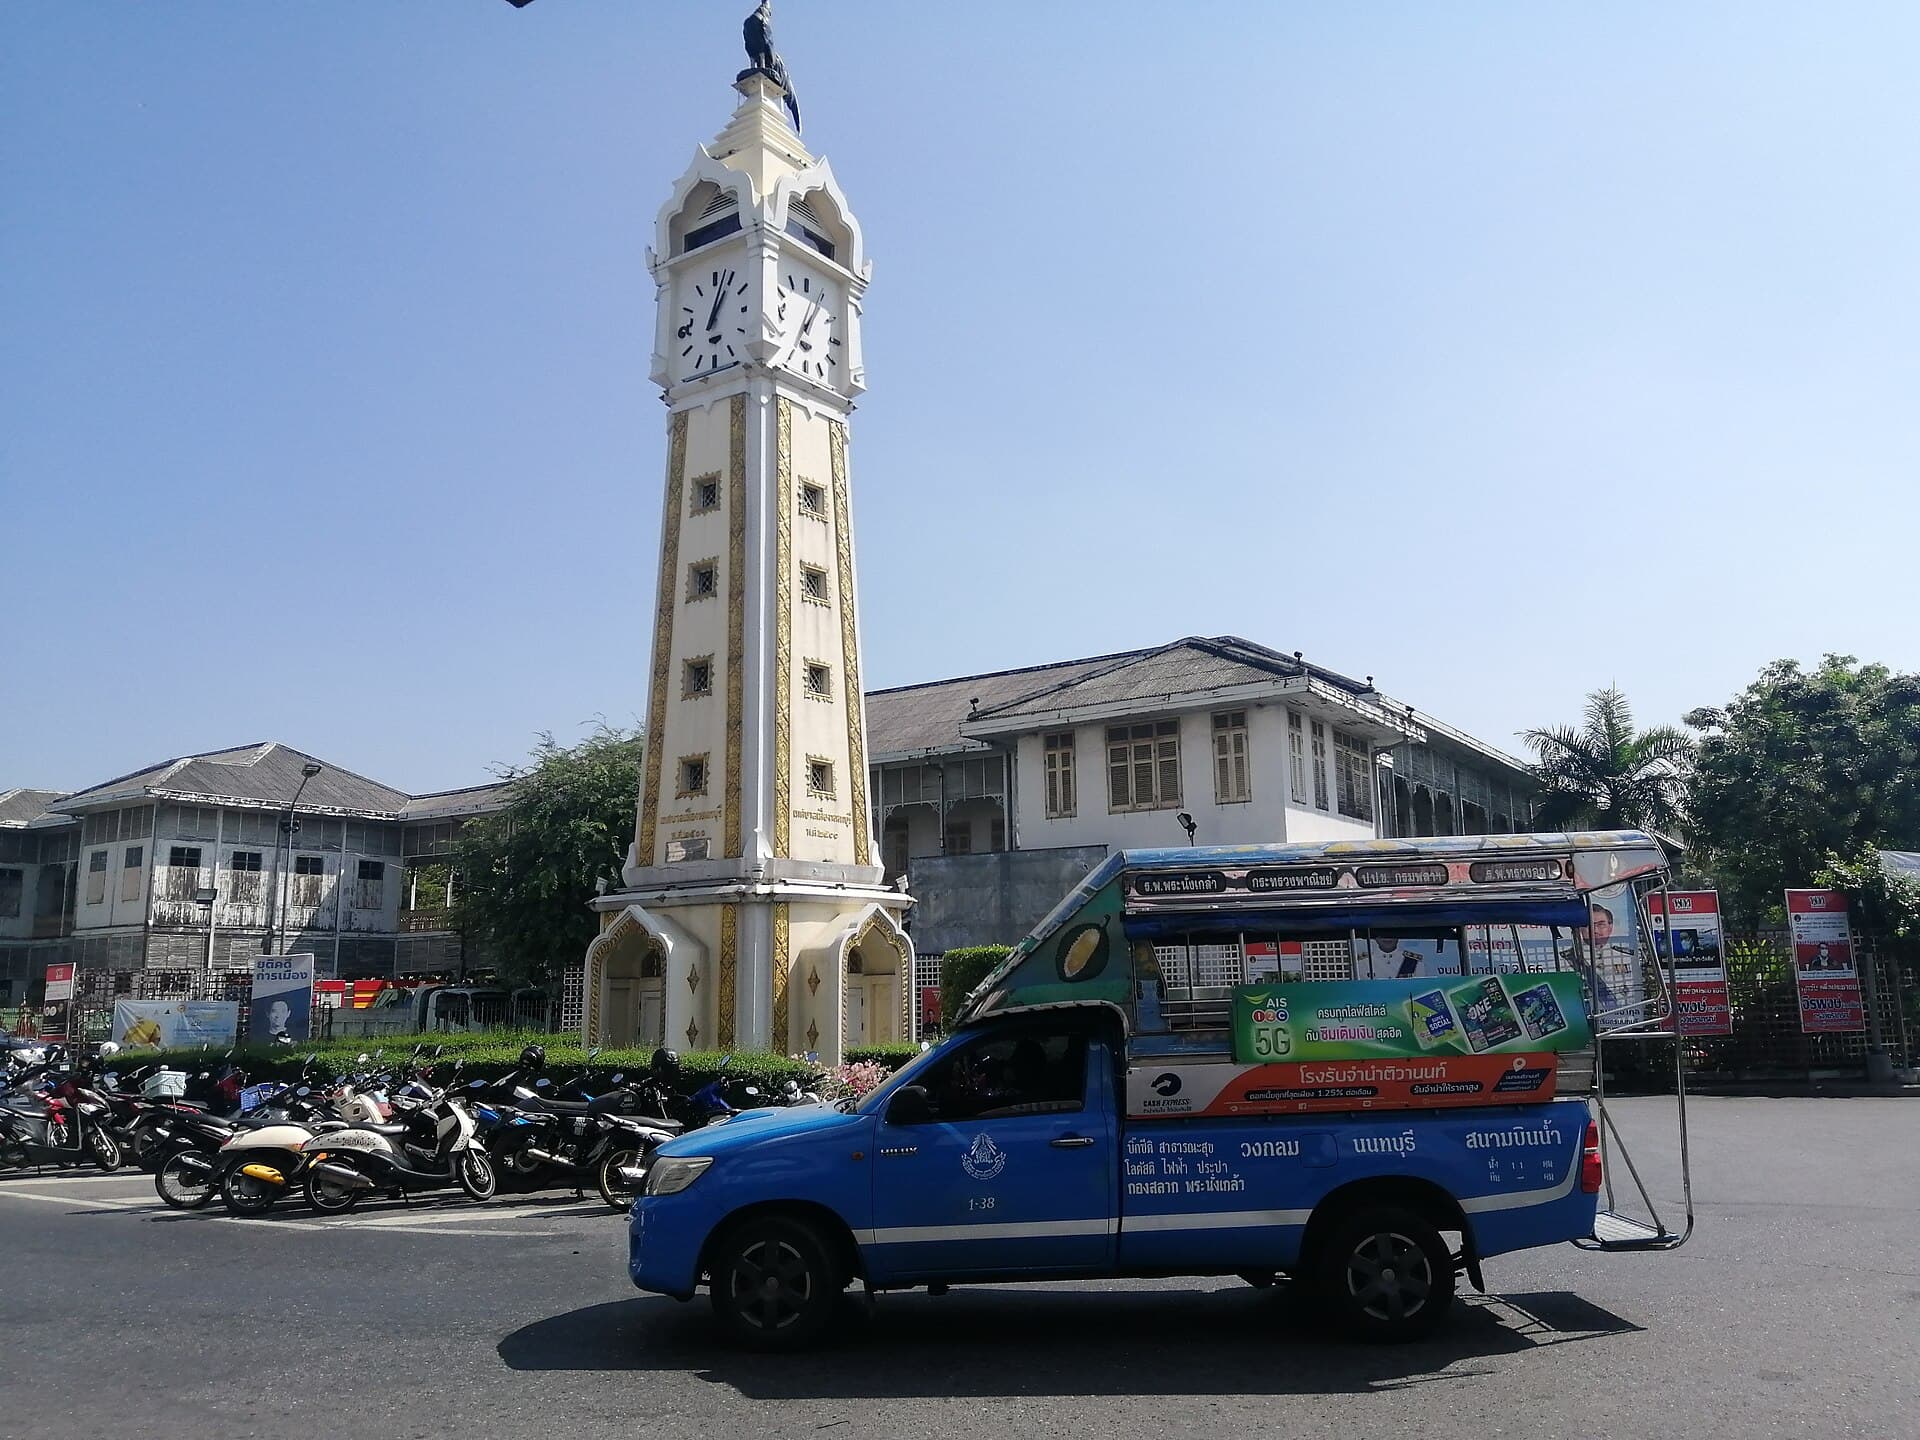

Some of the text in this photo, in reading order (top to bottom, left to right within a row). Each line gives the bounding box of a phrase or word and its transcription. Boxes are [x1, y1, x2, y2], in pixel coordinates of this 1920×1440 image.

[1251, 871, 1333, 889] กระทรวงพาณิชย์
[256, 969, 308, 981] การเมือง
[1512, 964, 1544, 975] 266
[1266, 998, 1288, 1008] AIS
[1468, 991, 1503, 1020] ONE 5G
[1317, 1003, 1387, 1023] ครบทุกไลฟ์สไตล์
[1429, 1018, 1451, 1031] SOCIAL
[1255, 1027, 1292, 1056] 5G
[1305, 1025, 1402, 1044] กับ ซิมเติมเงิน สุดฮิต
[1299, 1062, 1447, 1084] โรงรับจำนำติวานนท์
[1318, 1088, 1343, 1097] 1.25%
[1413, 1082, 1479, 1094] รับจำนำให้ราคาสูง
[1143, 1098, 1190, 1107] CASH EXPRESS
[1352, 1128, 1416, 1158] นนทบุรี
[1465, 1119, 1562, 1149] สนามบินน้ำ
[1240, 1139, 1300, 1158] วงกลม
[1161, 1156, 1188, 1175] ไฟฟ้า
[1196, 1159, 1228, 1174] ประปา
[1128, 1173, 1245, 1195] กองสลาก พระนั่งเกล้า
[969, 1197, 995, 1211] 1-38
